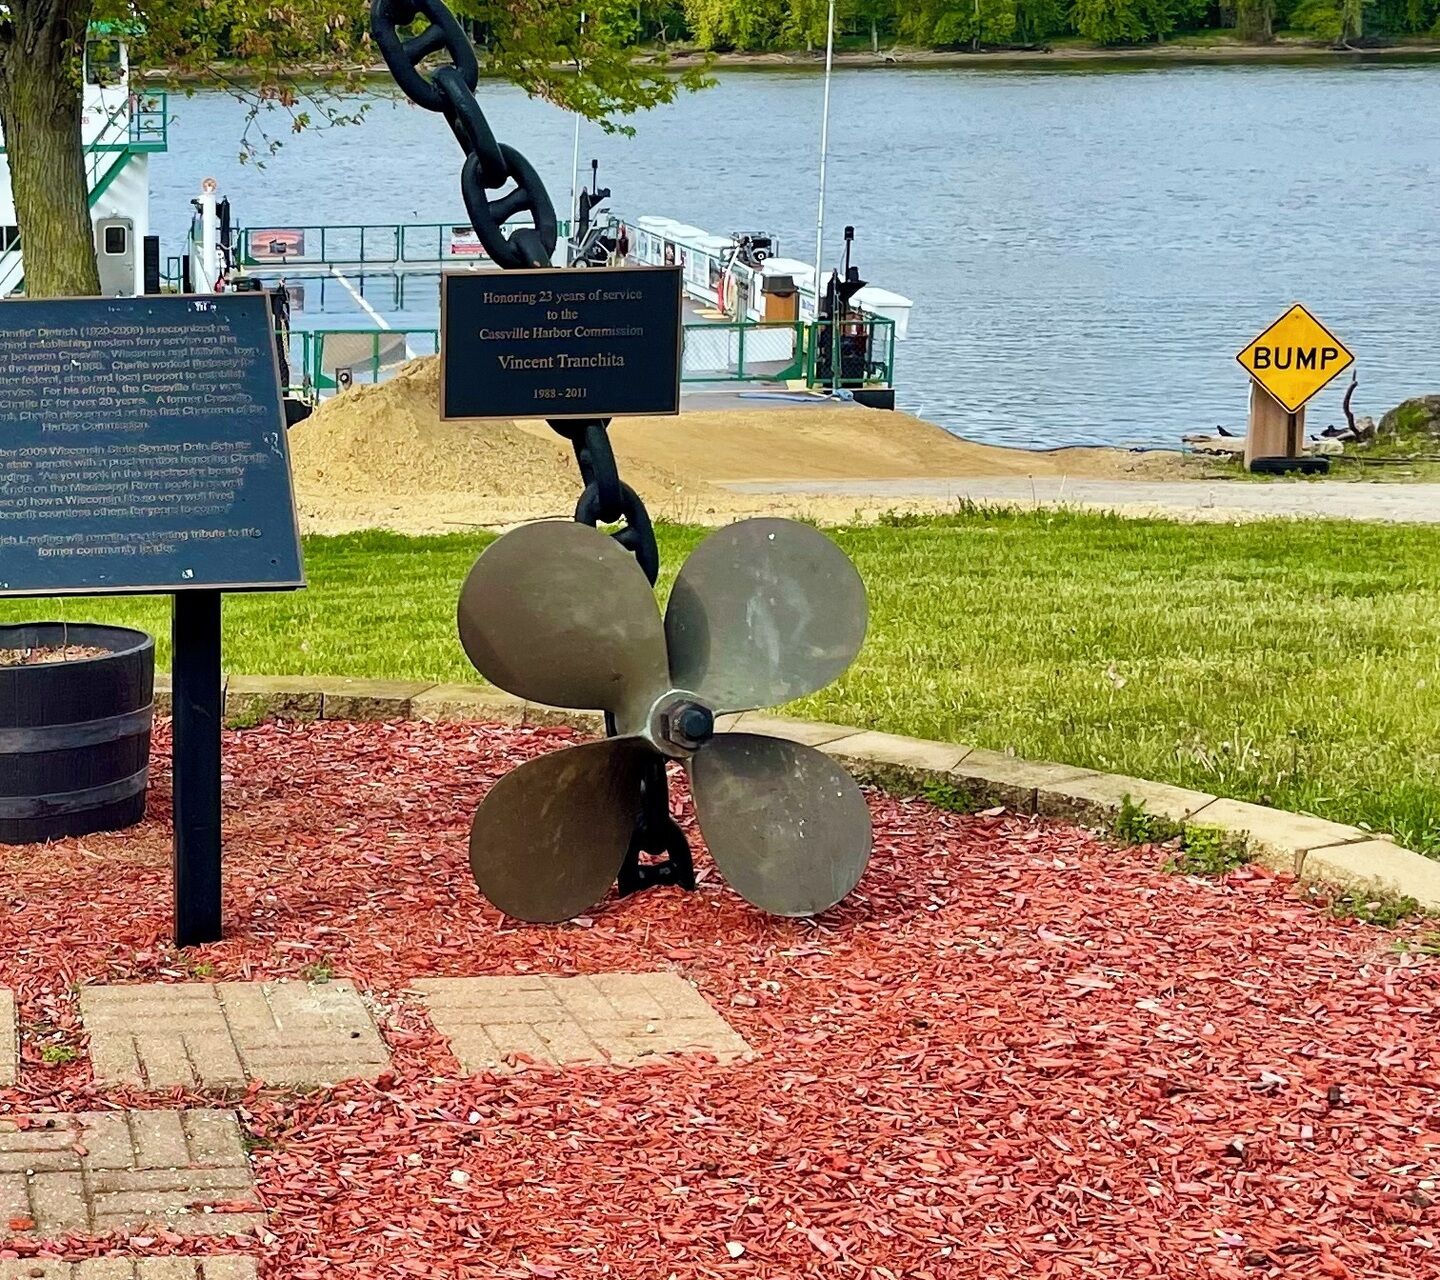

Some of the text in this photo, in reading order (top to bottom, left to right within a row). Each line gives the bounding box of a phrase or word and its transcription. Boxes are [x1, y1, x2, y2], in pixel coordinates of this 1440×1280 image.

[483, 289, 643, 306] Honoring 23 years of service
[547, 308, 578, 320] to the
[479, 325, 644, 340] Cassville Harbor Commission
[30, 338, 91, 351] establishing
[136, 336, 160, 347] ferry
[498, 351, 625, 370] Vincent Tranchita
[1253, 346, 1339, 370] BUMP
[28, 363, 60, 374] spring
[143, 372, 182, 383] support
[186, 371, 195, 380] to
[565, 387, 587, 398] 2011
[99, 397, 112, 406] 20
[156, 396, 165, 404] A
[19, 447, 47, 456] 2009
[50, 445, 104, 455] Wisconsin
[112, 469, 121, 478] in
[30, 496, 52, 506] how
[190, 528, 224, 538] tribute
[229, 528, 239, 537] to
[38, 546, 73, 556] former
[76, 544, 136, 557] community
